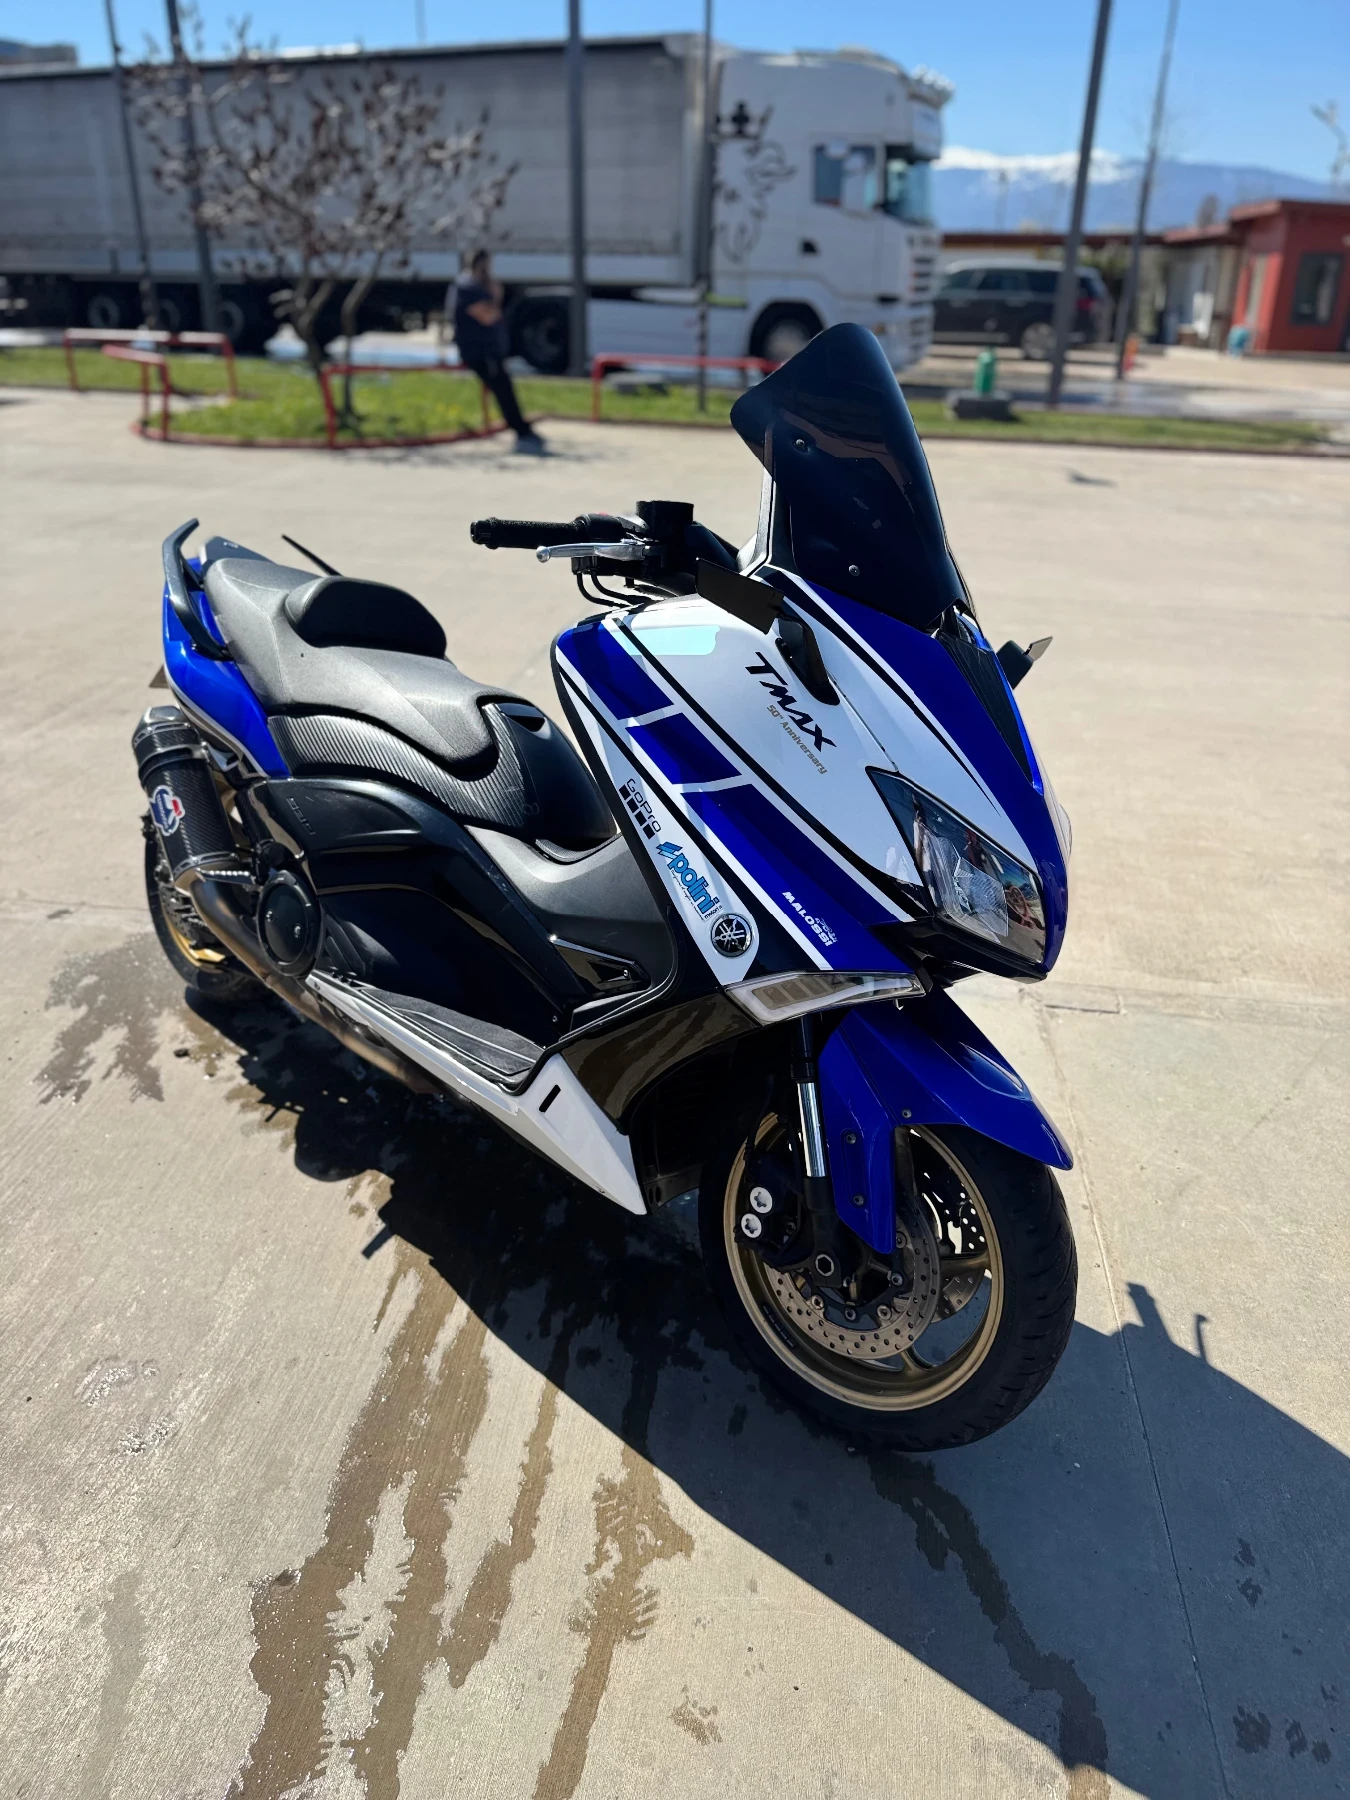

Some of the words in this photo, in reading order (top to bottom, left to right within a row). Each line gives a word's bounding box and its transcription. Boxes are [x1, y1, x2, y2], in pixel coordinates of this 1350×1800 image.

[745, 651, 837, 752] TMAX
[780, 721, 828, 774] Anniversary
[626, 778, 662, 833] GoPro
[667, 853, 720, 914] polini
[782, 891, 833, 946] MALOSSI
